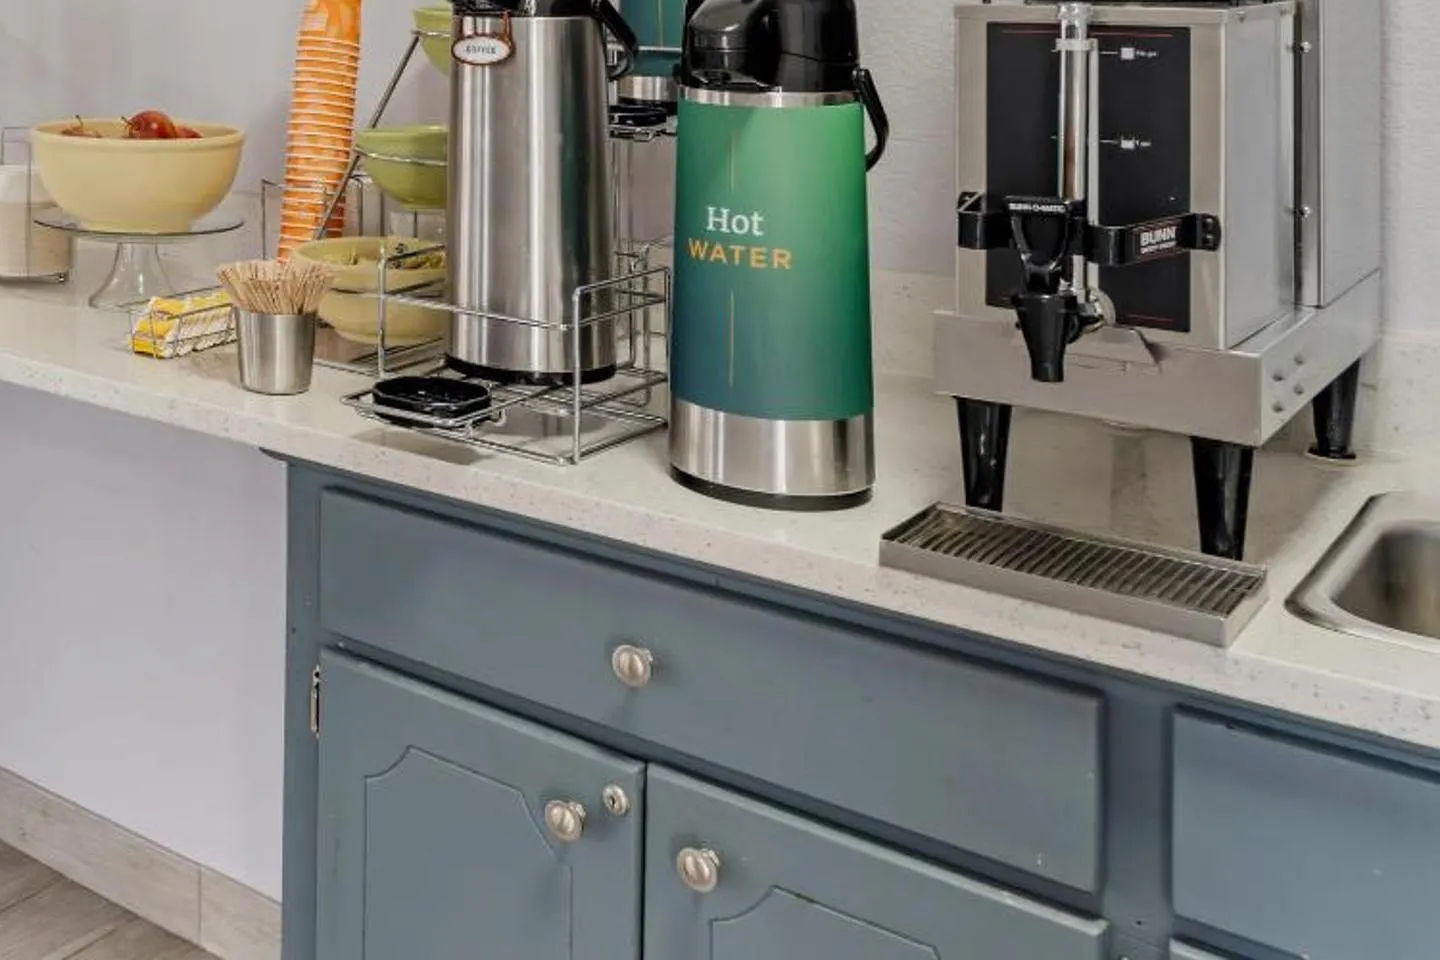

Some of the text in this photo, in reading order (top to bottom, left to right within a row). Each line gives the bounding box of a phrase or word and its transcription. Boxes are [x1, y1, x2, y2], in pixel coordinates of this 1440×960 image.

[706, 206, 765, 237] Hot
[1140, 226, 1177, 247] BUNN
[688, 237, 793, 270] WATER
